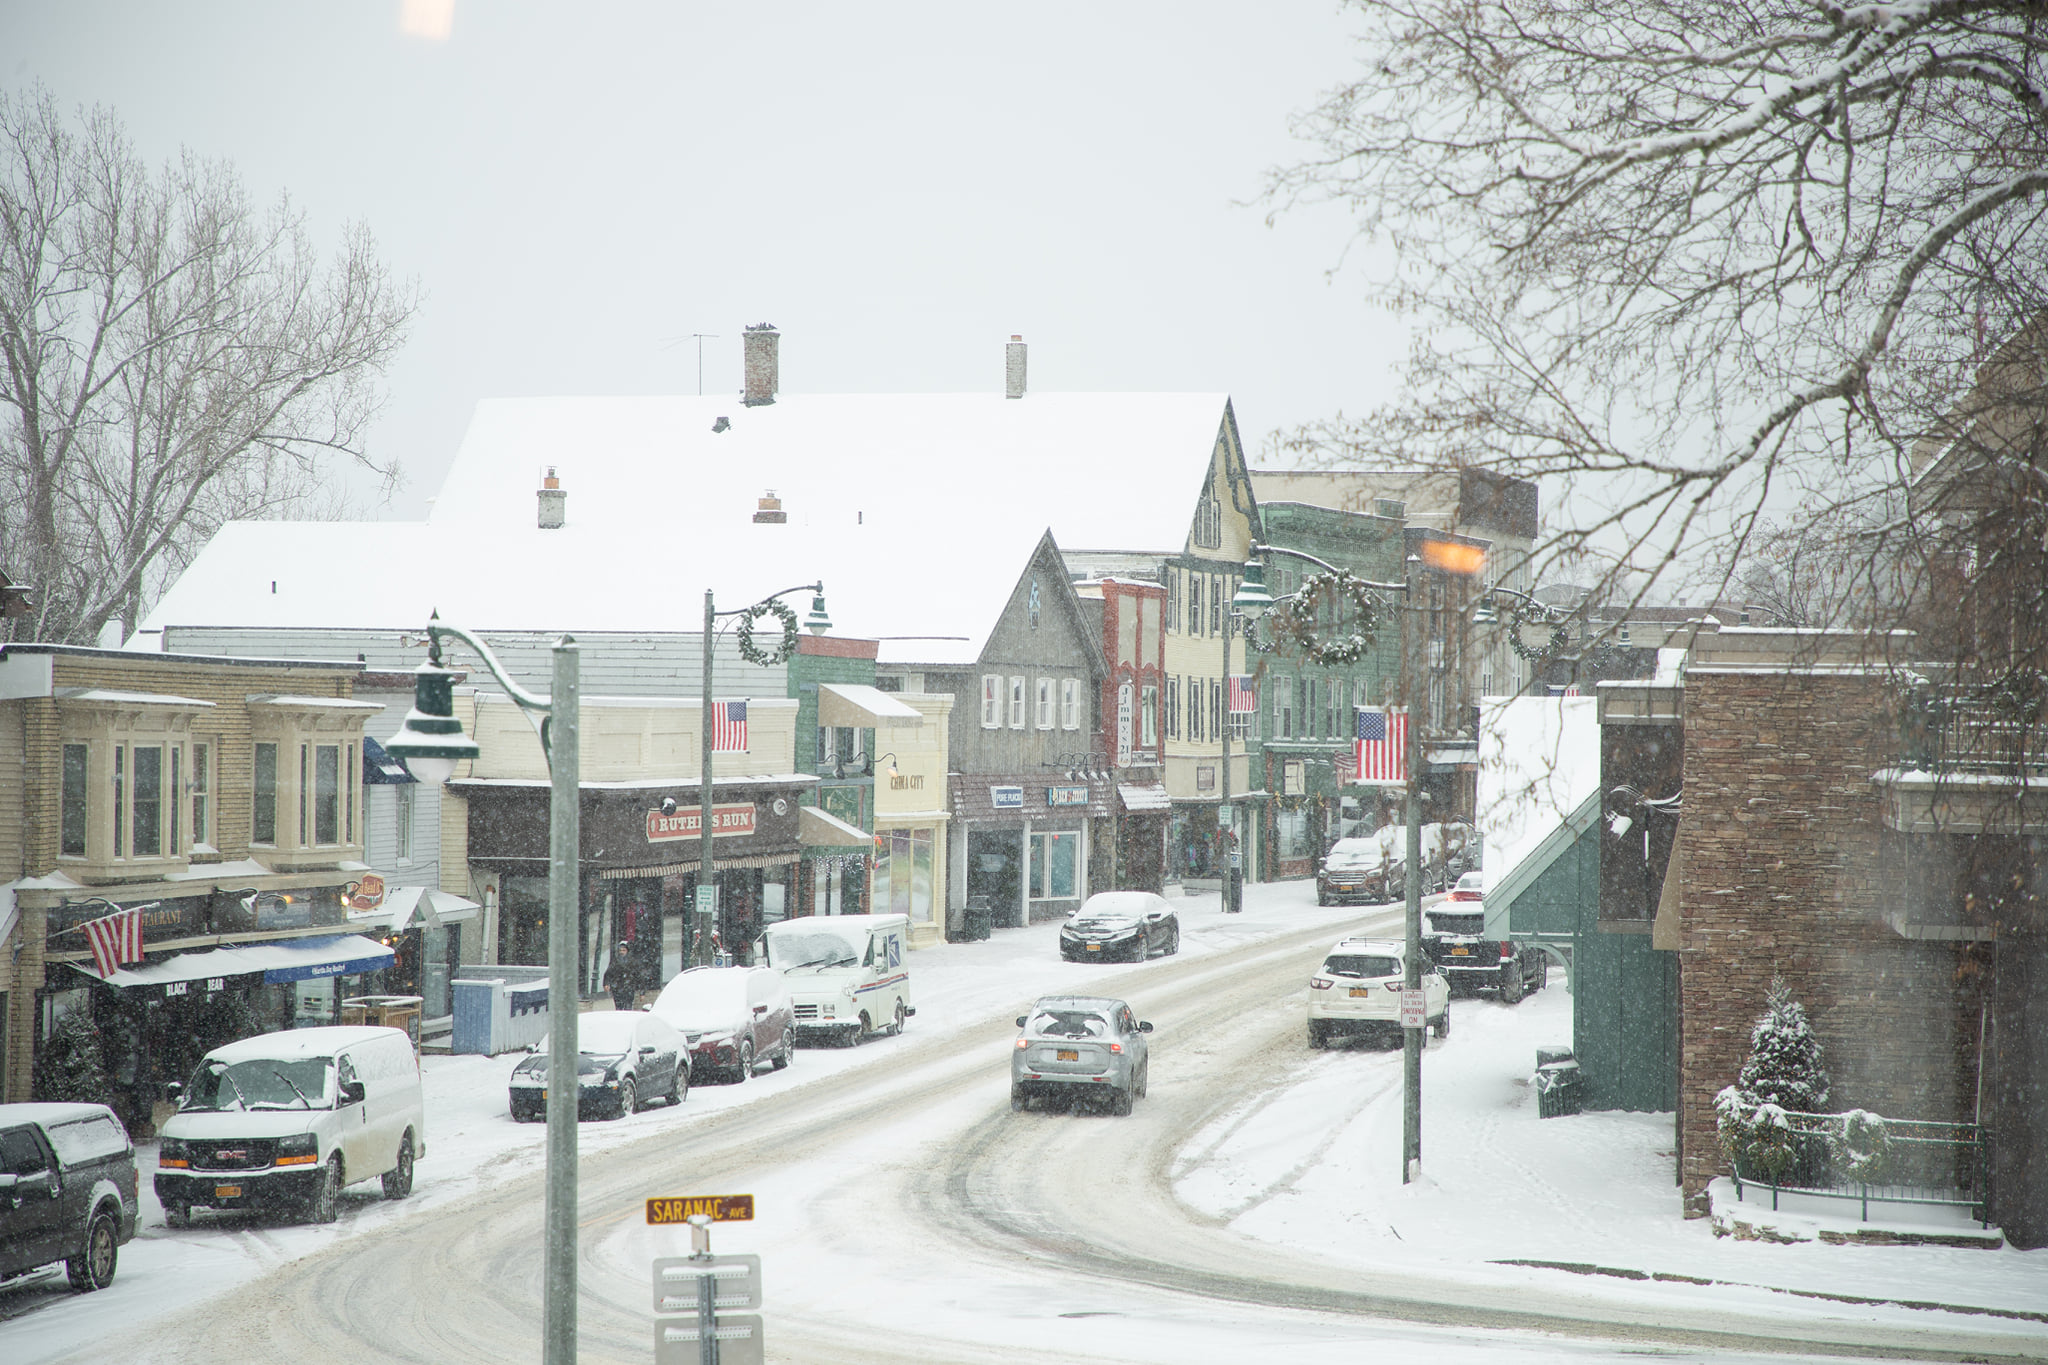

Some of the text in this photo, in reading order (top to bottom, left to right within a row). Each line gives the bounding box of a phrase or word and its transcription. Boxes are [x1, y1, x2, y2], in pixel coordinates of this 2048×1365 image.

[1120, 744, 1129, 754] 21
[890, 774, 925, 790] CHINA CITY
[722, 813, 749, 827] RUN
[166, 978, 224, 997] BLACK BEAR
[1408, 1016, 1418, 1024] NO
[216, 1150, 247, 1160] GMC
[653, 1199, 747, 1222] SARANAC AVE
